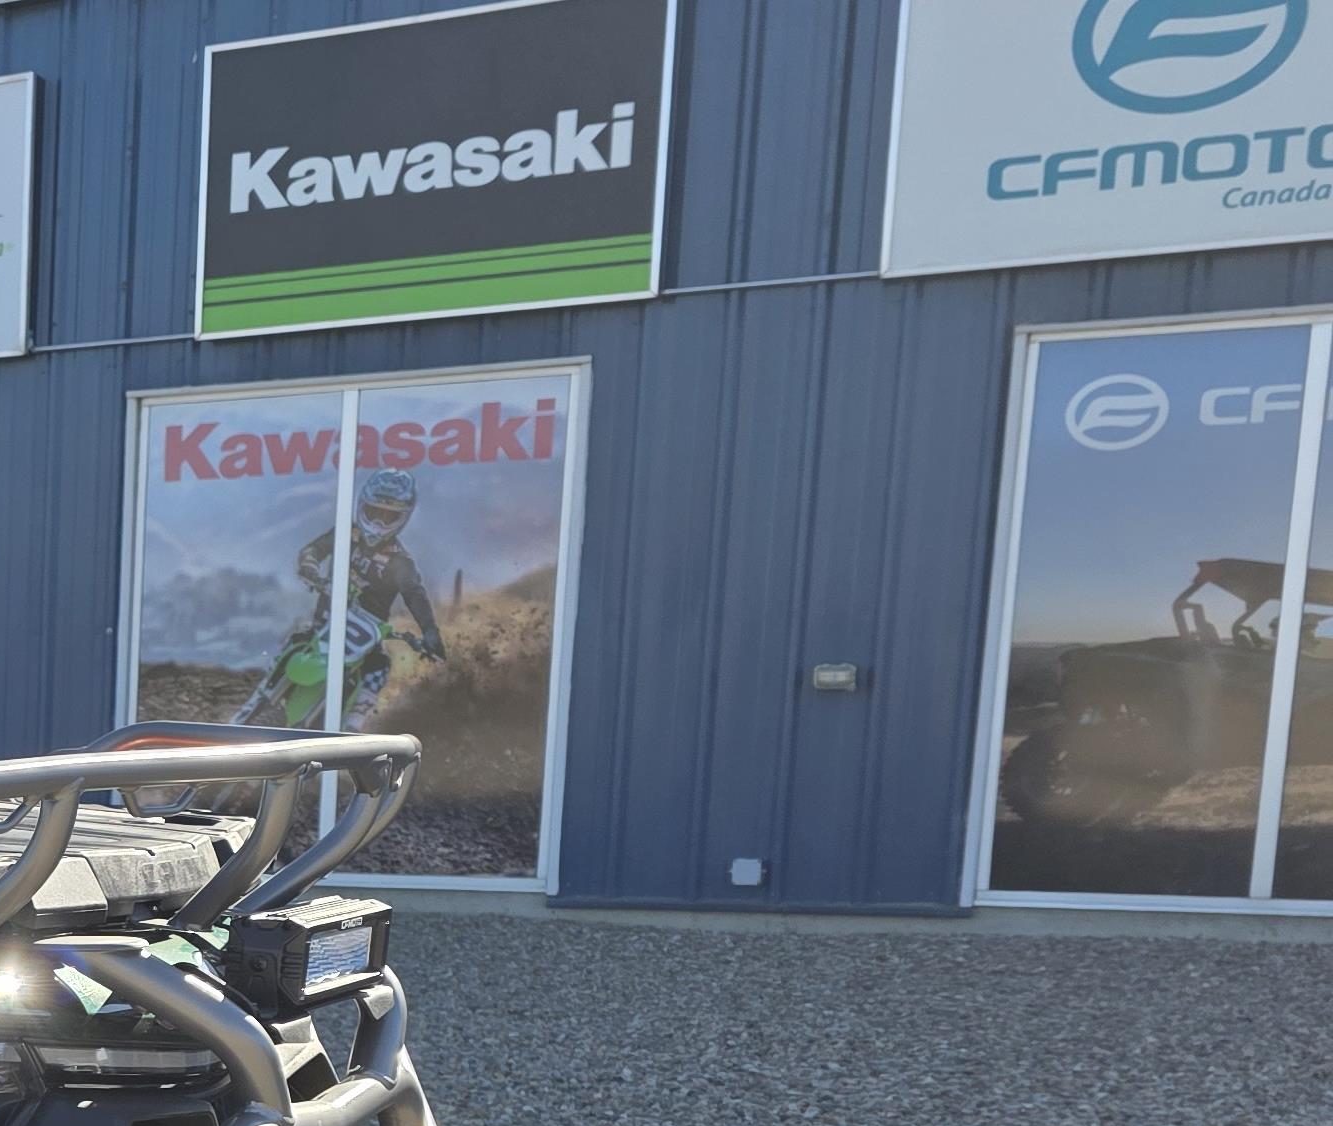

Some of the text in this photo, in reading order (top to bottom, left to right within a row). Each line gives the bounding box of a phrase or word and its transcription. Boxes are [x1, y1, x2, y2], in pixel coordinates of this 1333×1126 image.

[230, 102, 635, 213] Kawasaki
[1222, 180, 1333, 209] Canada
[1199, 383, 1333, 426] CF
[164, 398, 556, 482] Kawasaki
